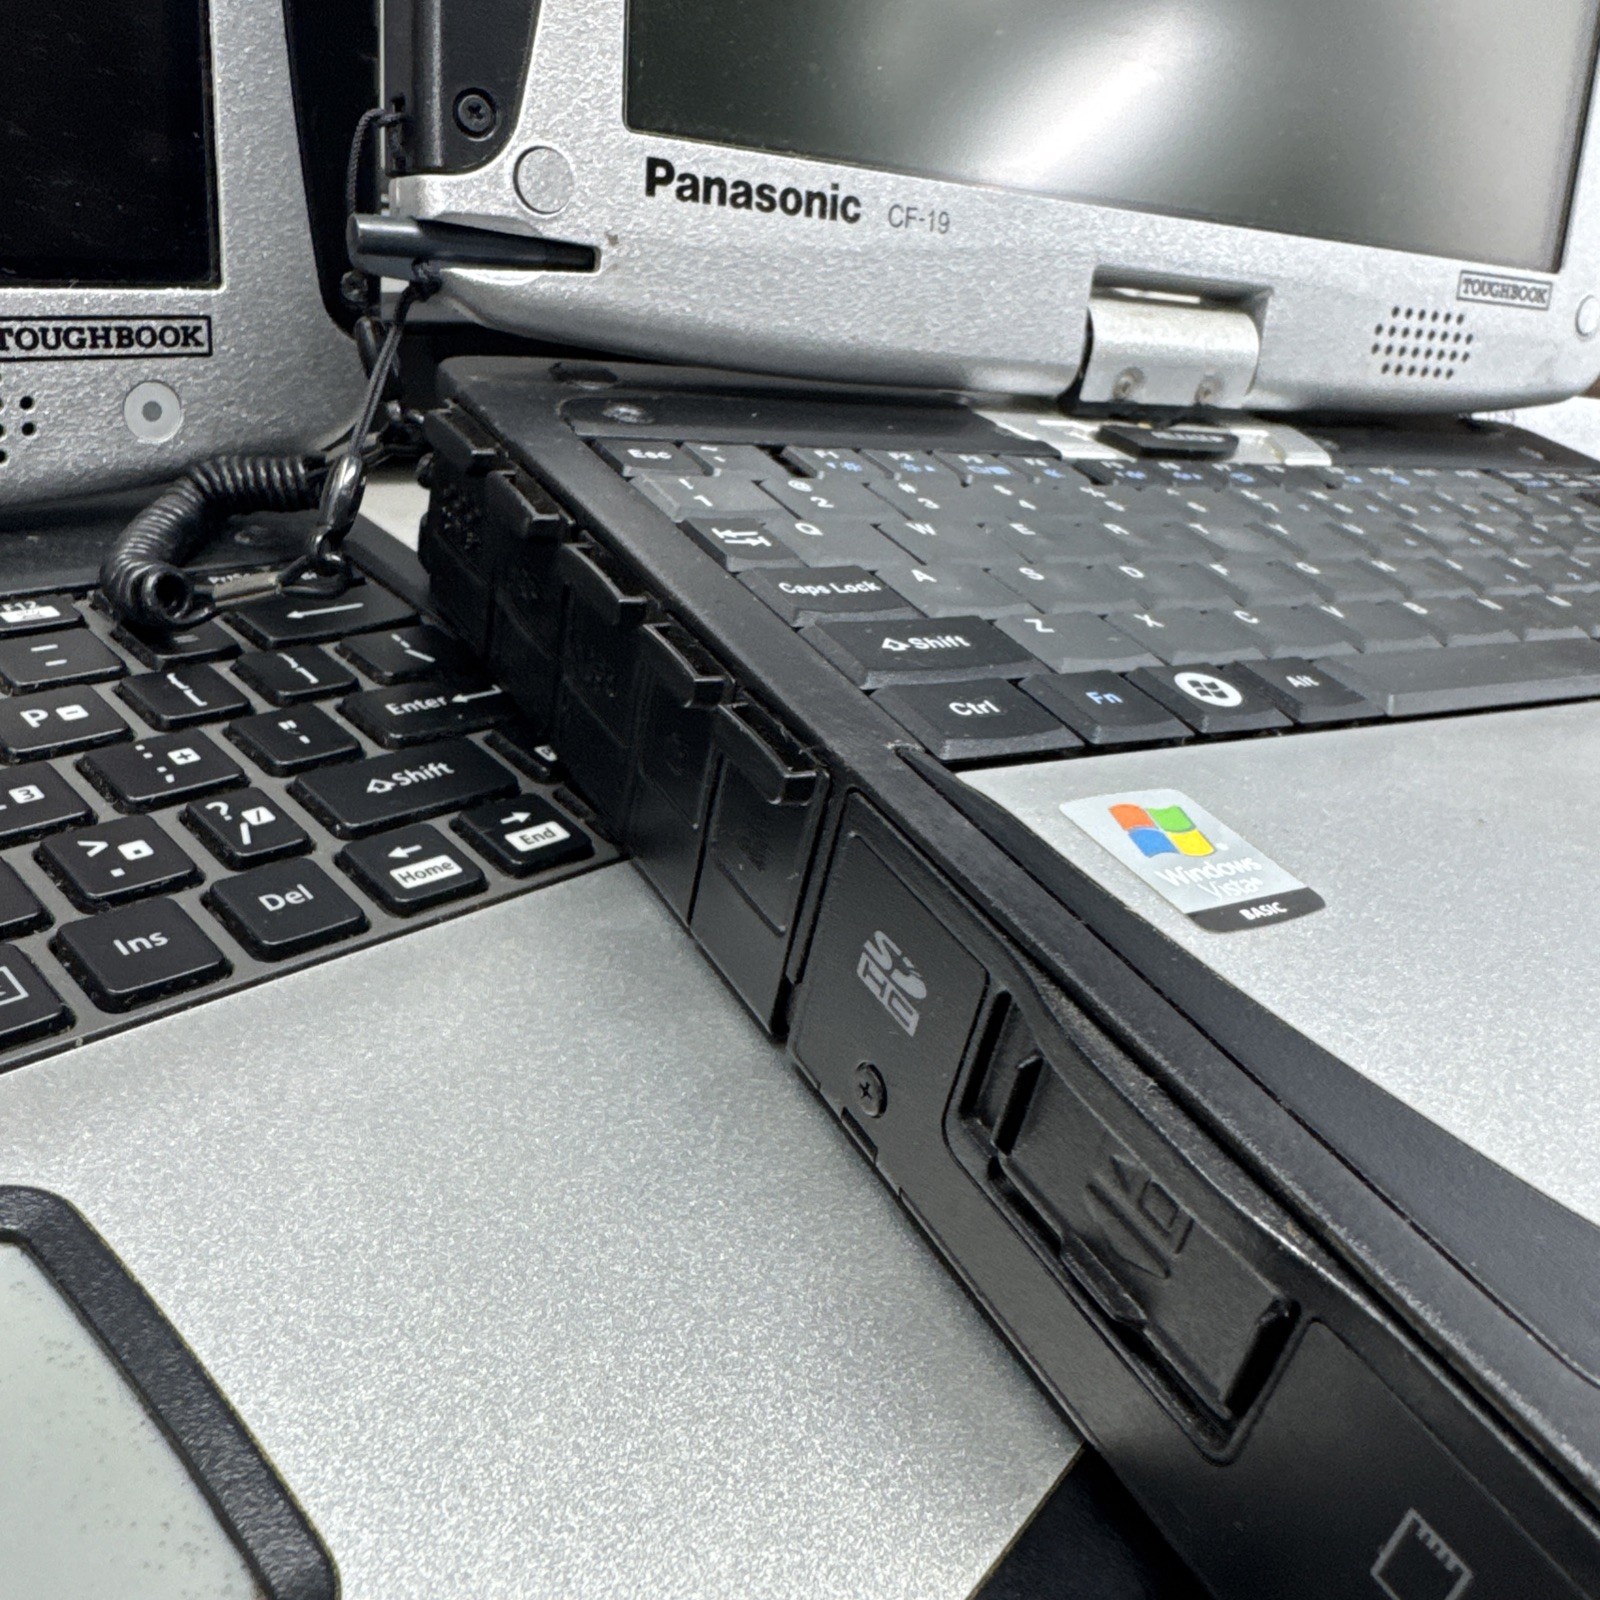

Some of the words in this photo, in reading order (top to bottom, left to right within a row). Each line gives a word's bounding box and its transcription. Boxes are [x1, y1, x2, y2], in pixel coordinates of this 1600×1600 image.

[645, 156, 861, 224] Panasonic
[887, 203, 950, 234] CF-19
[1463, 278, 1548, 304] TOUGHBOOK
[0, 326, 205, 351] TOUGHBOOK
[627, 448, 672, 460] Esc
[694, 494, 713, 507] 1
[810, 496, 834, 508] 2
[795, 522, 823, 536] Q
[905, 522, 937, 535] W
[1009, 523, 1036, 535] E
[911, 569, 937, 582] A
[1019, 567, 1045, 581] S
[1119, 565, 1145, 579] D
[778, 582, 830, 597] Caps
[830, 580, 882, 595] Lock
[1024, 618, 1055, 633] Z
[1134, 613, 1165, 628] X
[1233, 610, 1260, 624] C
[907, 634, 971, 651] Shift
[1286, 674, 1320, 688] Alt
[385, 695, 447, 716] Enter
[1085, 690, 1123, 705] Fn
[949, 700, 1001, 716] Ctrl
[20, 709, 48, 728] P
[392, 761, 454, 787] Shift
[205, 801, 233, 821] ?
[519, 826, 557, 846] End
[398, 859, 455, 884] Home
[1153, 857, 1263, 887] Windows
[1198, 877, 1264, 900] Vista
[258, 884, 314, 912] Del
[1239, 902, 1288, 920] BASIC
[113, 931, 168, 956] Ins
